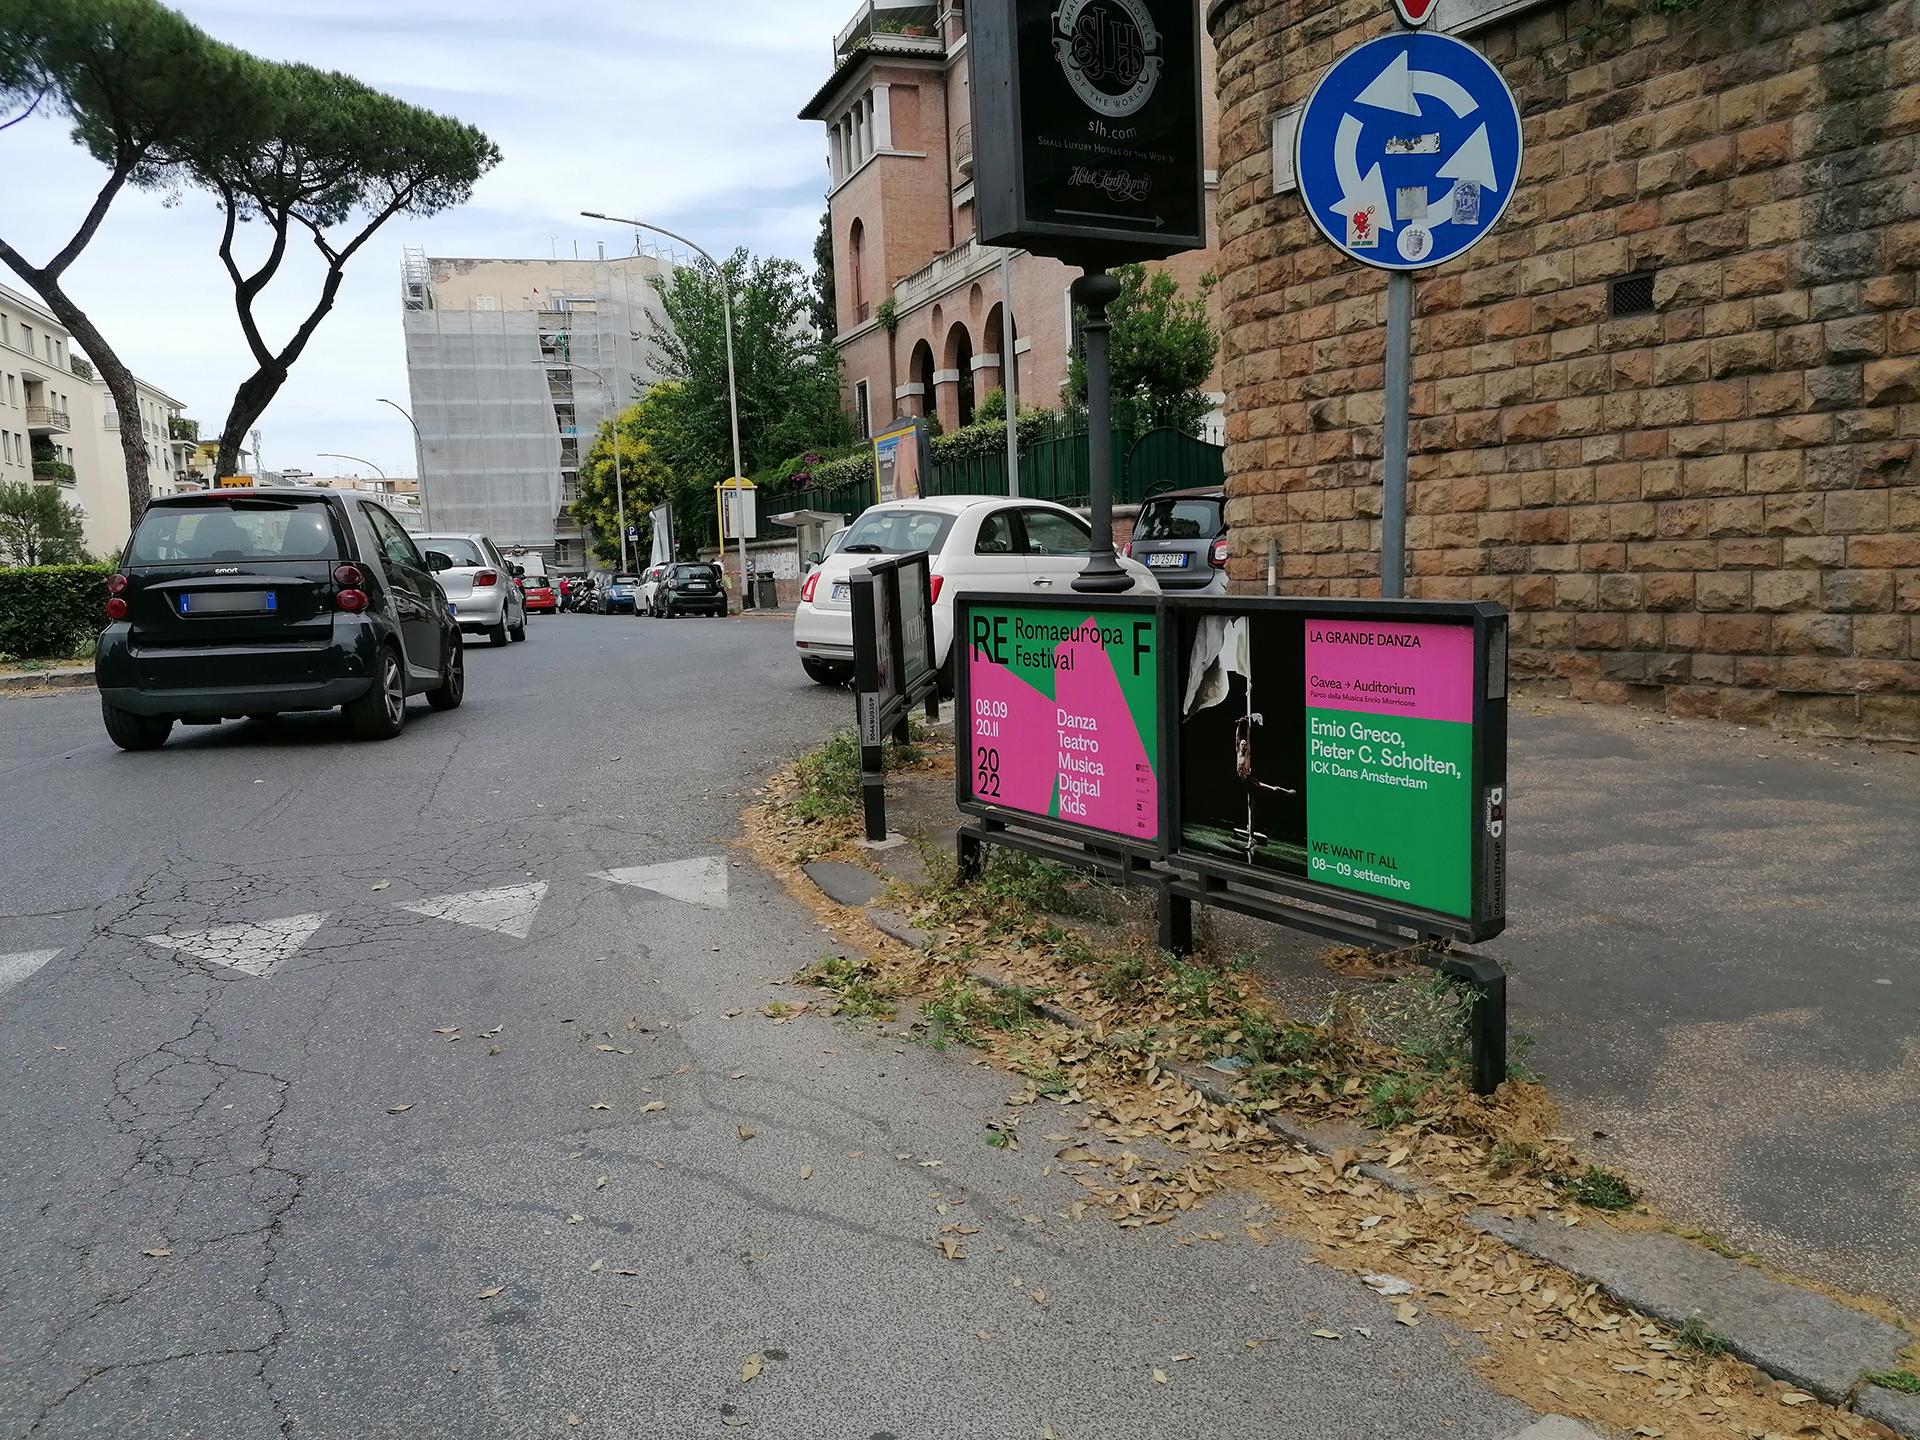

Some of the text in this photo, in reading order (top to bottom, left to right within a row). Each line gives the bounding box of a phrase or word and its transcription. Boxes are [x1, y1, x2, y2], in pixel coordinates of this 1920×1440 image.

[1074, 73, 1144, 108] OF THE WORLD
[1088, 120, 1137, 139] slh.com
[1068, 166, 1097, 186] Hotel
[629, 526, 635, 535] P
[214, 566, 238, 575] smart
[973, 615, 1009, 665] RE
[1132, 621, 1152, 676] F
[1015, 617, 1124, 651] Romaeuropa
[1310, 631, 1422, 648] LA GRANDE DANZA
[1015, 645, 1074, 671] Festival
[1310, 675, 1416, 696] Cavea Auditorium
[975, 698, 1008, 719] 08.09
[1310, 690, 1416, 707] Parco della Musica Ennio Morricone
[1056, 708, 1098, 731] Danza
[1057, 730, 1099, 753] Teatro
[1311, 717, 1405, 748] Emio Greco,
[977, 746, 999, 773] 20
[1058, 751, 1104, 776] Musica
[1311, 739, 1461, 779] Pieter C. Scholten,
[978, 771, 1001, 798] 22
[1058, 773, 1100, 798] Digital
[1311, 760, 1427, 790] ICK Dans Amsterdam
[1059, 794, 1087, 816] Kids
[1312, 840, 1398, 870] WE WANT IT ALL
[1353, 868, 1411, 890] settembre
